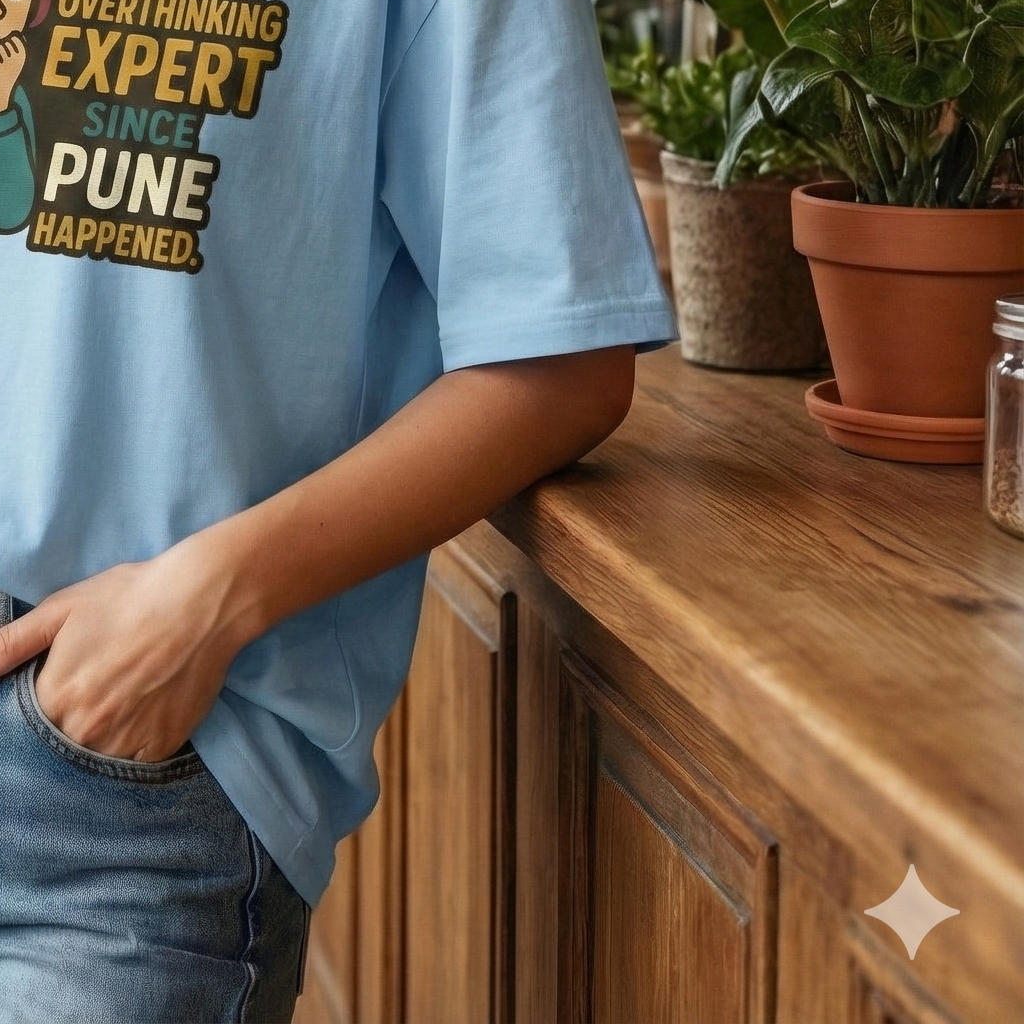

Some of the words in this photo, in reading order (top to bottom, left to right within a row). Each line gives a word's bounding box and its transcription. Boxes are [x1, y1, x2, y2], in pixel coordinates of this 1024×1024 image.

[41, 25, 275, 112] EXPERT
[82, 101, 197, 149] SINCE
[43, 142, 214, 221] PUNE
[33, 211, 197, 267] HAPPENED.
